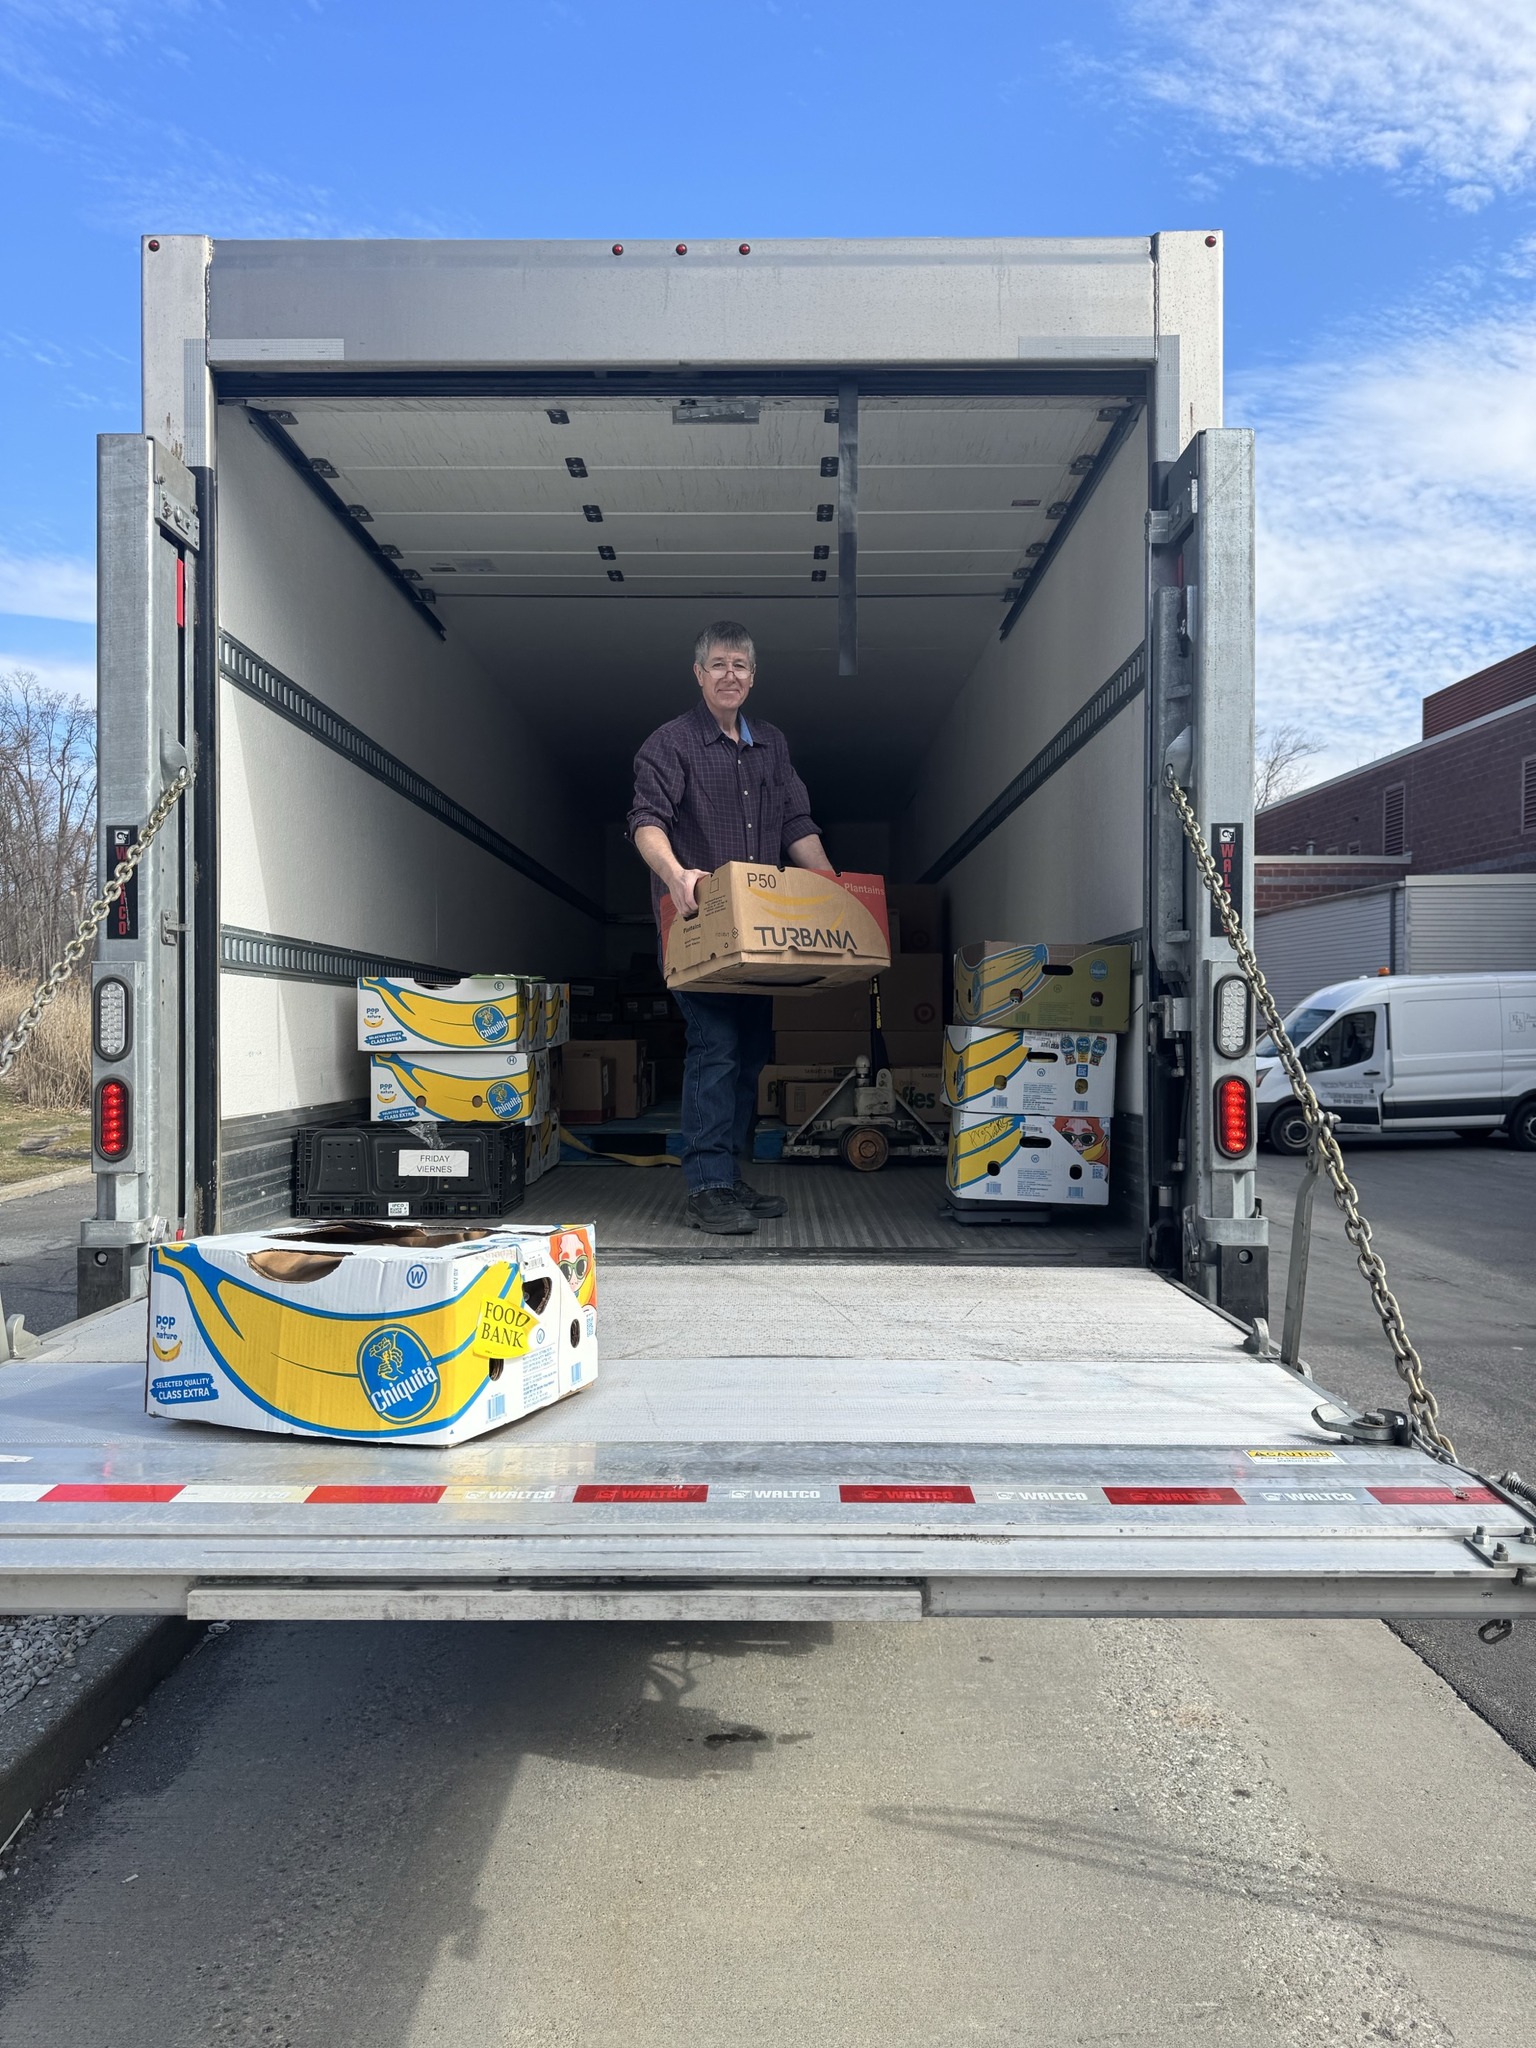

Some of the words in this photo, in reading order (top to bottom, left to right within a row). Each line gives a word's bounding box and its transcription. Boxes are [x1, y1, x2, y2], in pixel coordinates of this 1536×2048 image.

[746, 872, 777, 889] P50
[844, 882, 885, 895] Plantains
[1220, 843, 1235, 932] WAL
[753, 926, 858, 950] TURBANA
[479, 1020, 507, 1040] Chiquita
[493, 1096, 522, 1116] Chiquita
[420, 1154, 450, 1162] FRIDAY
[416, 1165, 452, 1173] VIERNES
[484, 1301, 531, 1328] FOOD
[156, 1315, 176, 1329] pop
[156, 1331, 178, 1340] nature
[481, 1322, 524, 1348] BANK
[156, 1380, 183, 1389] SELECTED
[184, 1377, 210, 1387] QUALITY
[370, 1364, 438, 1413] Chiquita
[158, 1390, 182, 1400] CLASS
[183, 1387, 210, 1398] EXTRA
[488, 1490, 555, 1499] WALTCO
[621, 1490, 689, 1499] WALTCO
[754, 1490, 820, 1499] WALTCO
[885, 1490, 954, 1499] WALTCO
[1018, 1491, 1088, 1501] WALTCO
[1152, 1491, 1223, 1501] WALTCO
[1286, 1492, 1357, 1501] WALTCO
